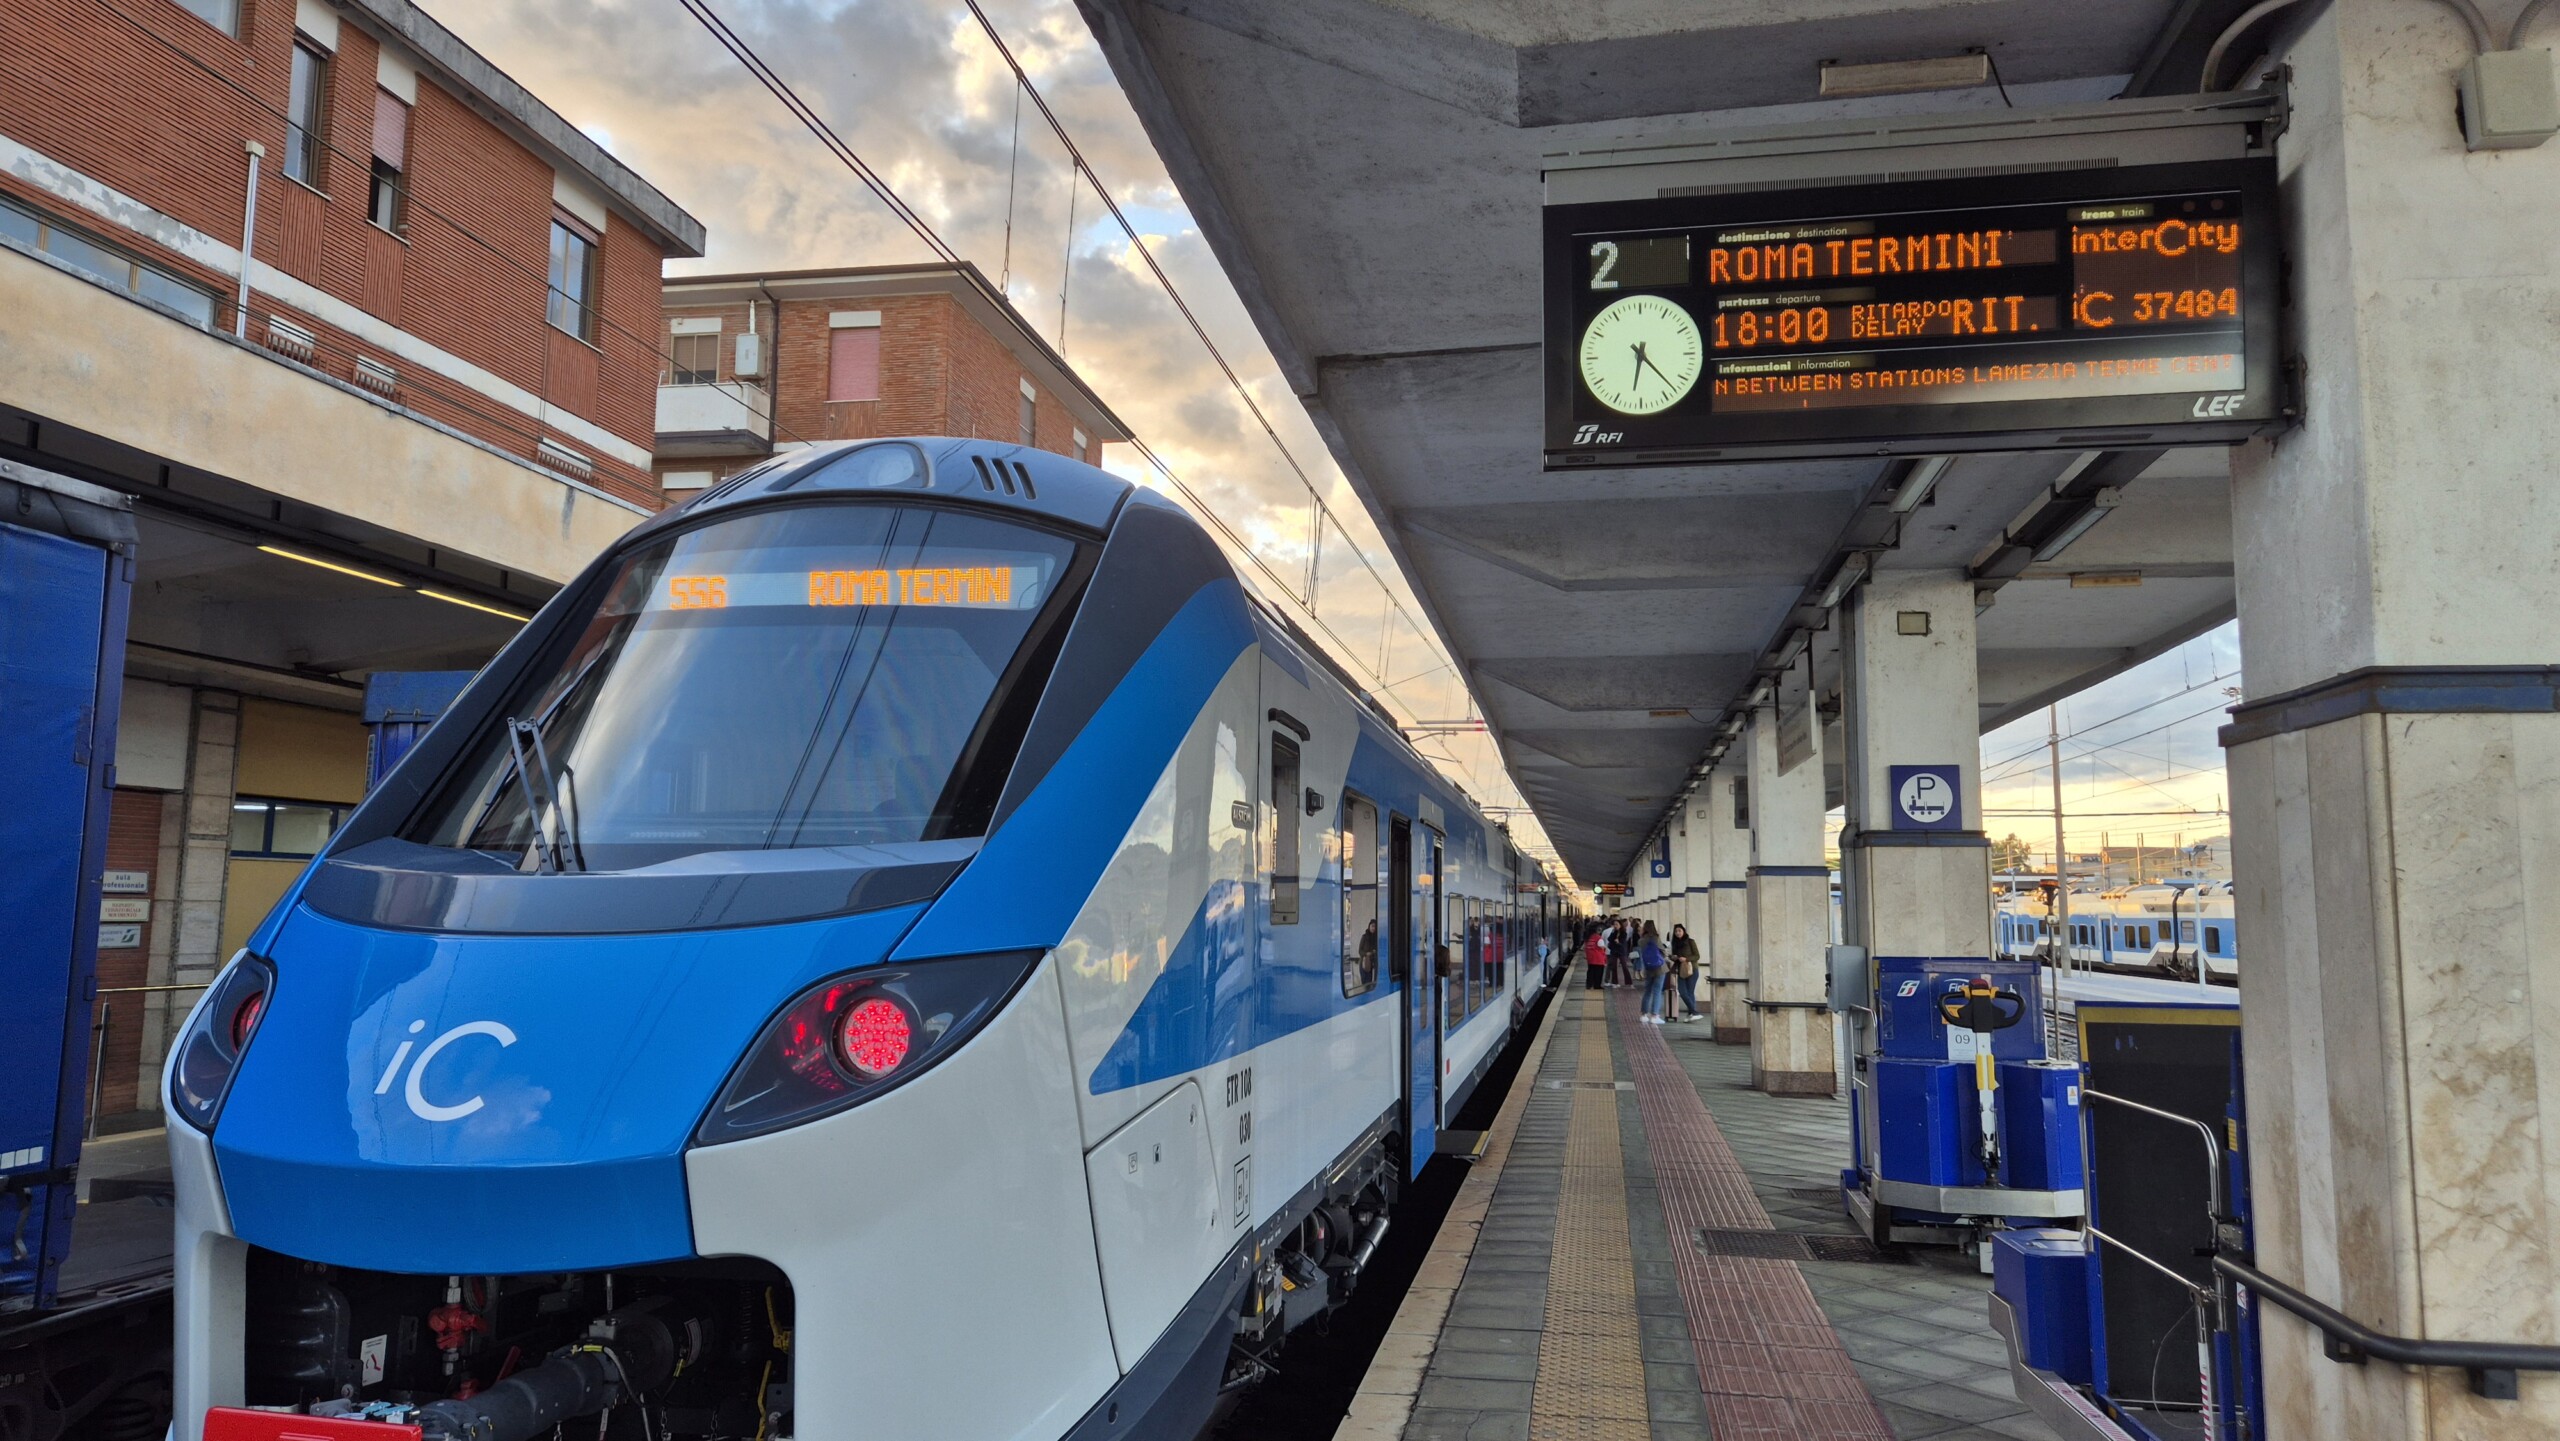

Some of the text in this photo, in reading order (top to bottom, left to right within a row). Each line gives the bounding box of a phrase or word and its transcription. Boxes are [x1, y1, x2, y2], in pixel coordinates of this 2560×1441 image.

[2081, 207, 2145, 219] treno train
[1718, 226, 1847, 243] destinazione destination
[1590, 241, 1618, 290] 2
[1710, 230, 2002, 283] ROMA TERMINI
[1718, 293, 1821, 309] partenza departure
[1851, 300, 1950, 320] RITARDO
[1952, 295, 2039, 334] RIT.
[2072, 288, 2238, 328] iC 37484
[1714, 306, 1829, 348] 18:00
[1851, 317, 1926, 338] DELAY
[1715, 378, 1728, 395] N
[1736, 373, 1842, 394] BETWEEN
[1850, 366, 1965, 389] STATIONS
[1973, 361, 2077, 384] LAMEZIA
[2084, 357, 2161, 378] TERME
[1718, 358, 1851, 374] informazioni information
[1595, 432, 1624, 444] RFI
[669, 566, 1011, 610] 556 ROMA TERMINI
[1916, 776, 1935, 800] P
[1955, 1034, 1970, 1044] 09
[374, 1019, 517, 1122] iC
[1226, 1073, 1239, 1108] ETR
